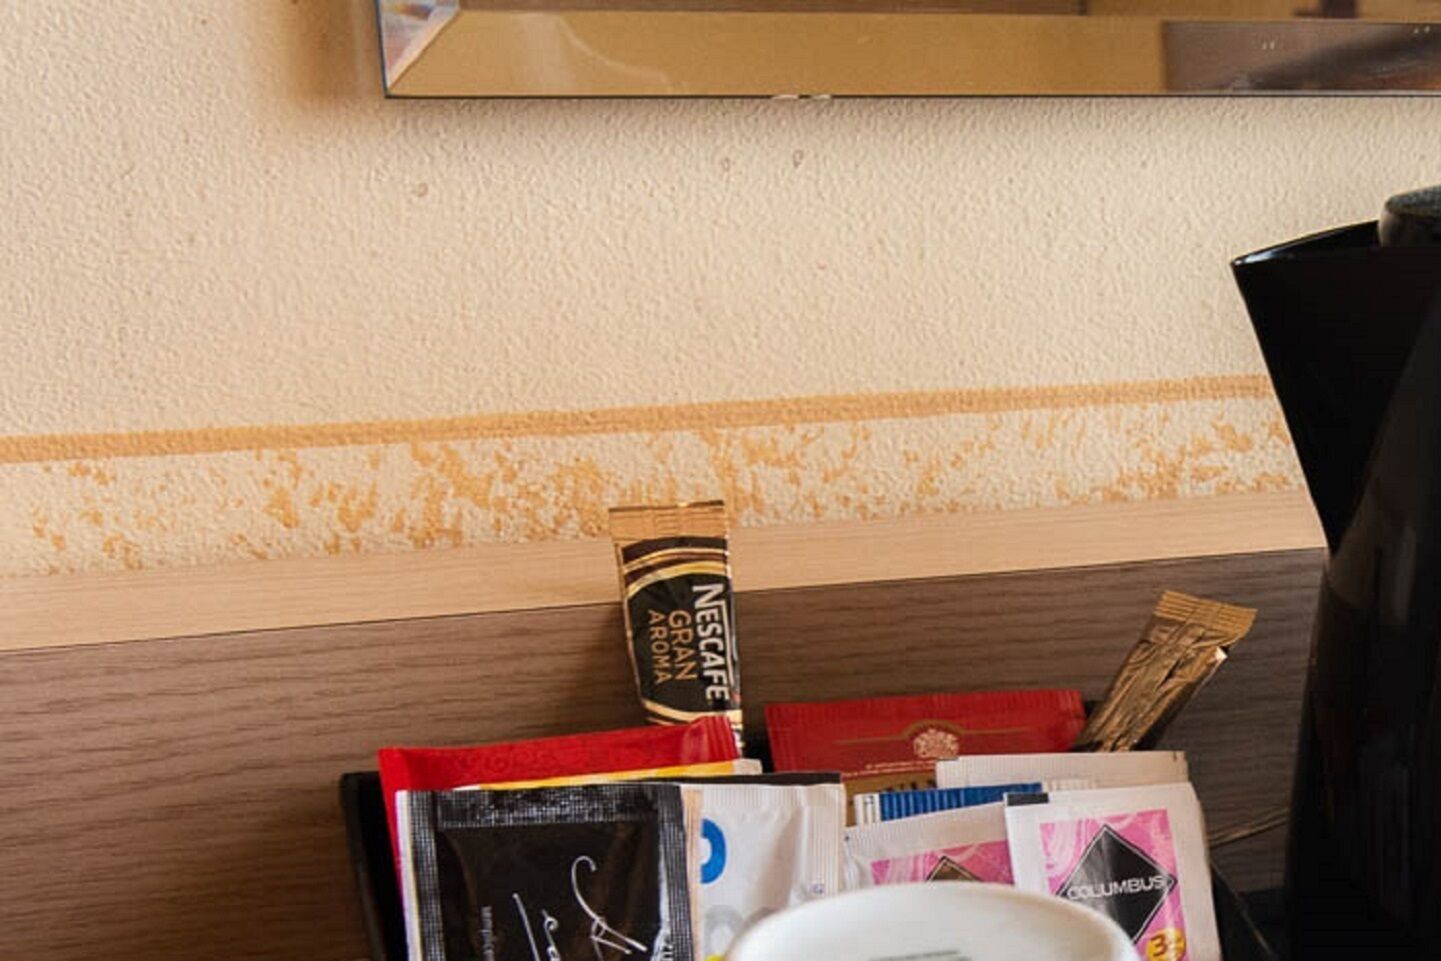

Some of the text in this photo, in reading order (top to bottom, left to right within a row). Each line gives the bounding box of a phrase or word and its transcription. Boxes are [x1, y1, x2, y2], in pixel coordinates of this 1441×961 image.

[648, 609, 671, 685] AROMA
[668, 609, 698, 681] GRAN
[1066, 875, 1167, 900] COLUMBUS
